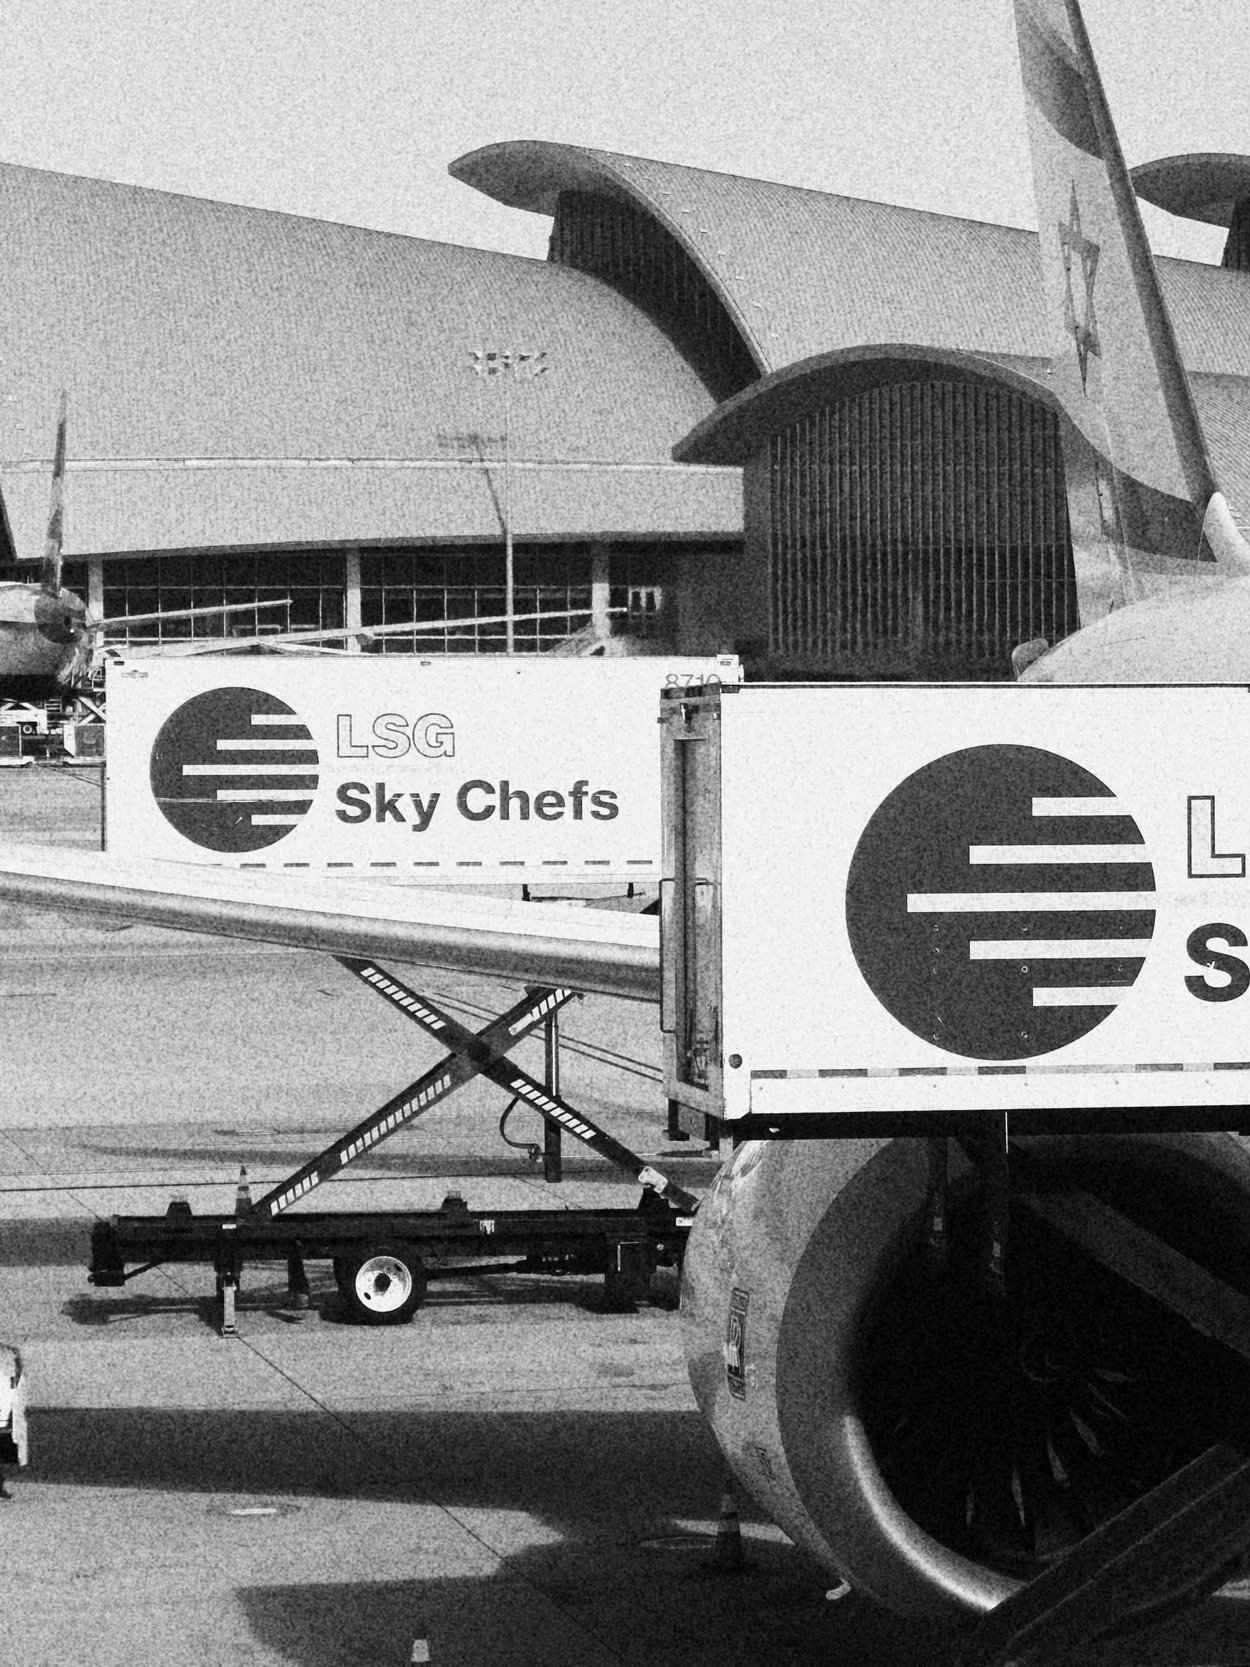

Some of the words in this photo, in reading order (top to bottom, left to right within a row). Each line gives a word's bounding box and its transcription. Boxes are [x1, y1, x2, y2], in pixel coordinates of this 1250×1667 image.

[336, 713, 456, 759] LSG
[335, 781, 440, 832] Sky
[456, 779, 620, 822] Chefs
